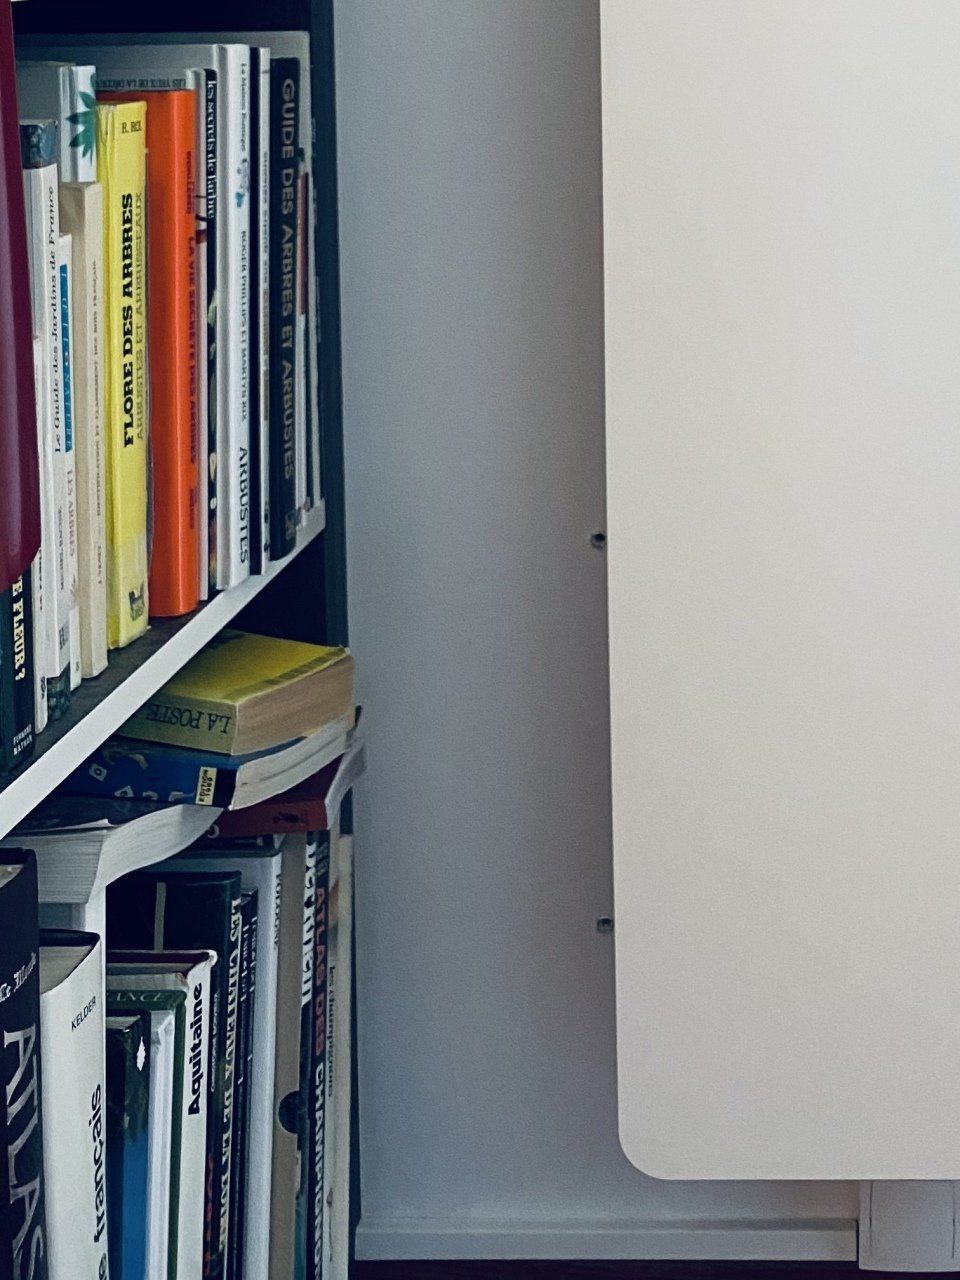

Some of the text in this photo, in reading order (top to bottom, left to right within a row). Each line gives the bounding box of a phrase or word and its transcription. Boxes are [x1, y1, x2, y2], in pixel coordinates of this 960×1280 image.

[207, 80, 217, 99] les
[207, 102, 217, 151] secrets
[207, 153, 217, 172] de
[282, 78, 295, 479] GUIDE DES ARBRES ET ARBUSTES
[47, 186, 61, 453] Le Guide des Jardins de France
[122, 193, 134, 448] FLORE DES ARBRES
[134, 192, 144, 440] ARBUSTES ET ARBRISSEAUX
[239, 446, 249, 564] ARBUSTES
[13, 597, 25, 670] FLEUR
[13, 734, 33, 756] NATHAN
[146, 704, 232, 735] LA POSTE
[230, 899, 242, 942] LES
[316, 887, 326, 986] ATLAS
[71, 995, 96, 1031] KELDER
[316, 992, 325, 1056] DES
[188, 982, 203, 1116] Aquitaine
[223, 1090, 233, 1123] DE
[3, 1024, 43, 1280] ATLAS
